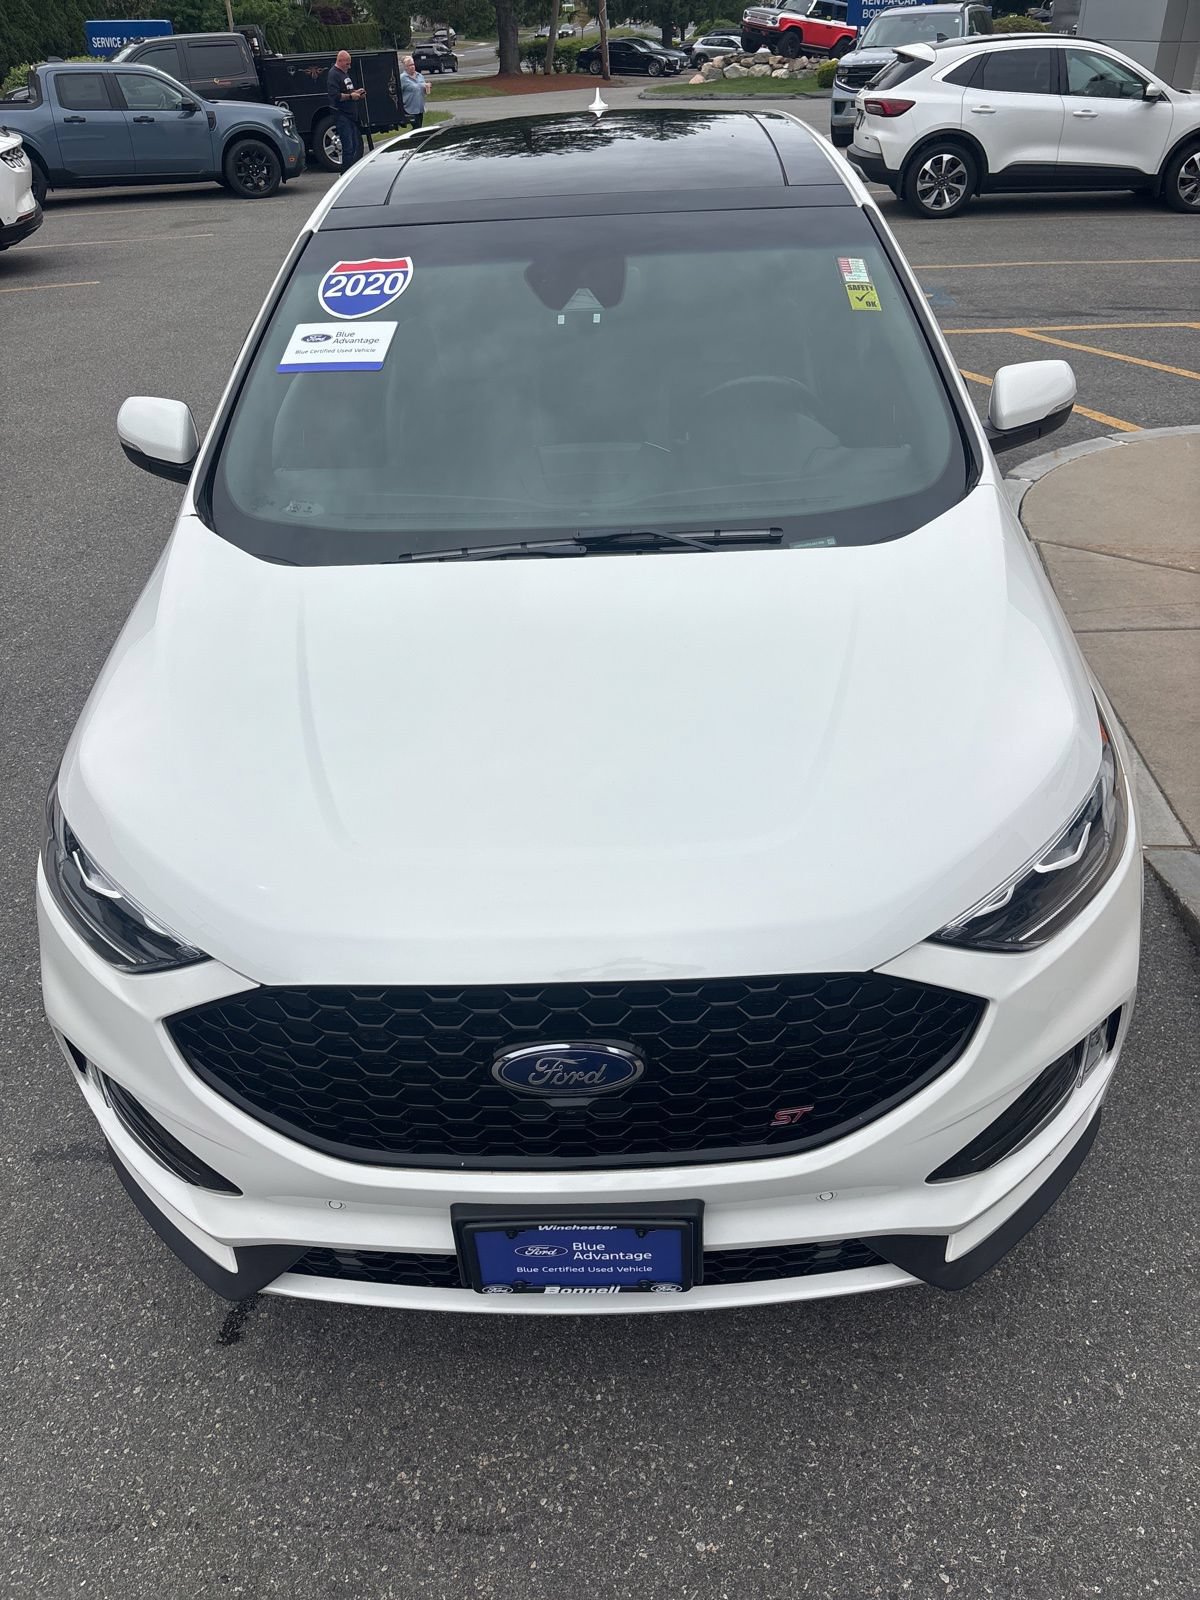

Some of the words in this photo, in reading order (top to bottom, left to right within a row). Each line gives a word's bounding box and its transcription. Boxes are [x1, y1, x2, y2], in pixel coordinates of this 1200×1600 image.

[862, 9, 883, 18] BOD
[91, 36, 122, 48] SERVICE
[323, 272, 405, 297] 2020
[305, 334, 328, 343] Ford
[332, 337, 380, 345] Advantage
[527, 1056, 608, 1086] Ford
[770, 1105, 815, 1127] ST
[525, 1245, 559, 1257] Ford
[573, 1242, 606, 1252] Blue
[573, 1251, 653, 1262] Advantage
[542, 1265, 585, 1273] Certified
[616, 1265, 653, 1273] Vehicle
[544, 1286, 621, 1294] Bonnell
